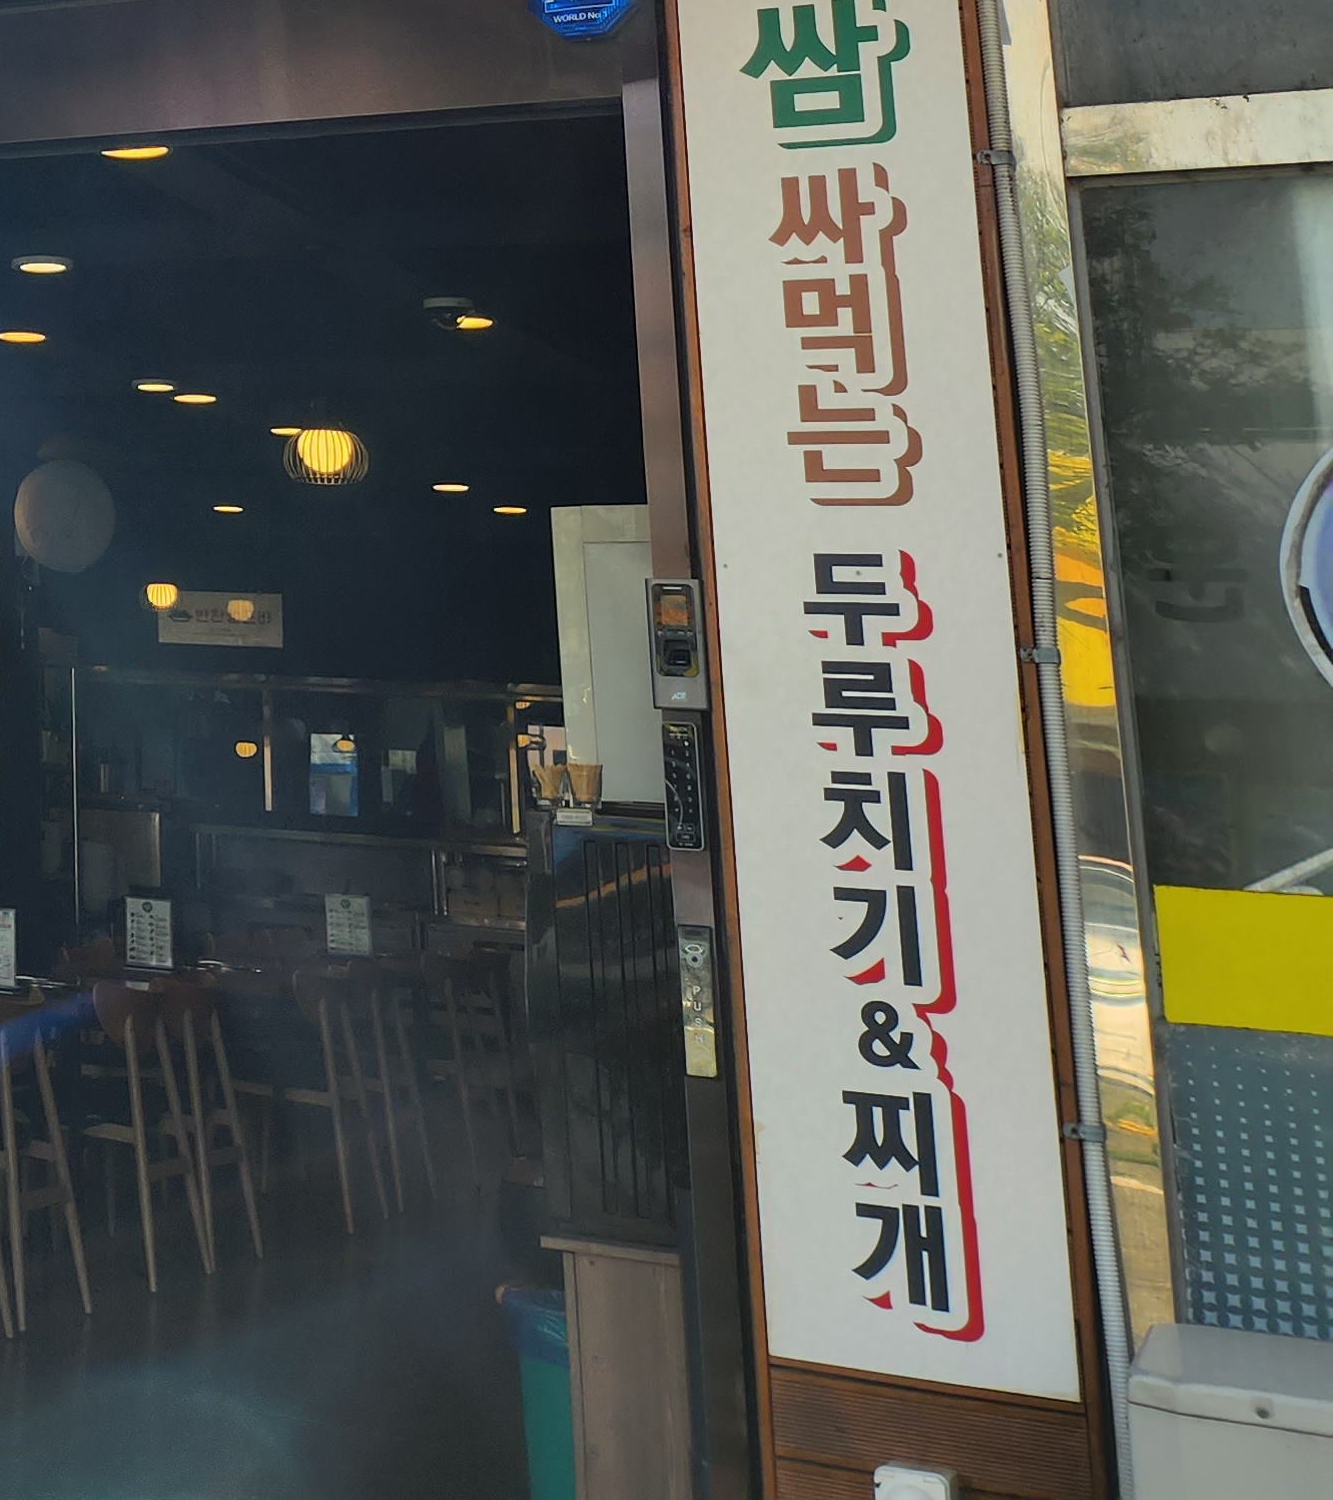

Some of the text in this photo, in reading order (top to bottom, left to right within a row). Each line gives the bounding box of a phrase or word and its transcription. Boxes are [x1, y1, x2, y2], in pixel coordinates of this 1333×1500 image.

[553, 13, 586, 23] WORLD
[769, 165, 906, 494] 싸먹는
[692, 985, 704, 1044] PUSH
